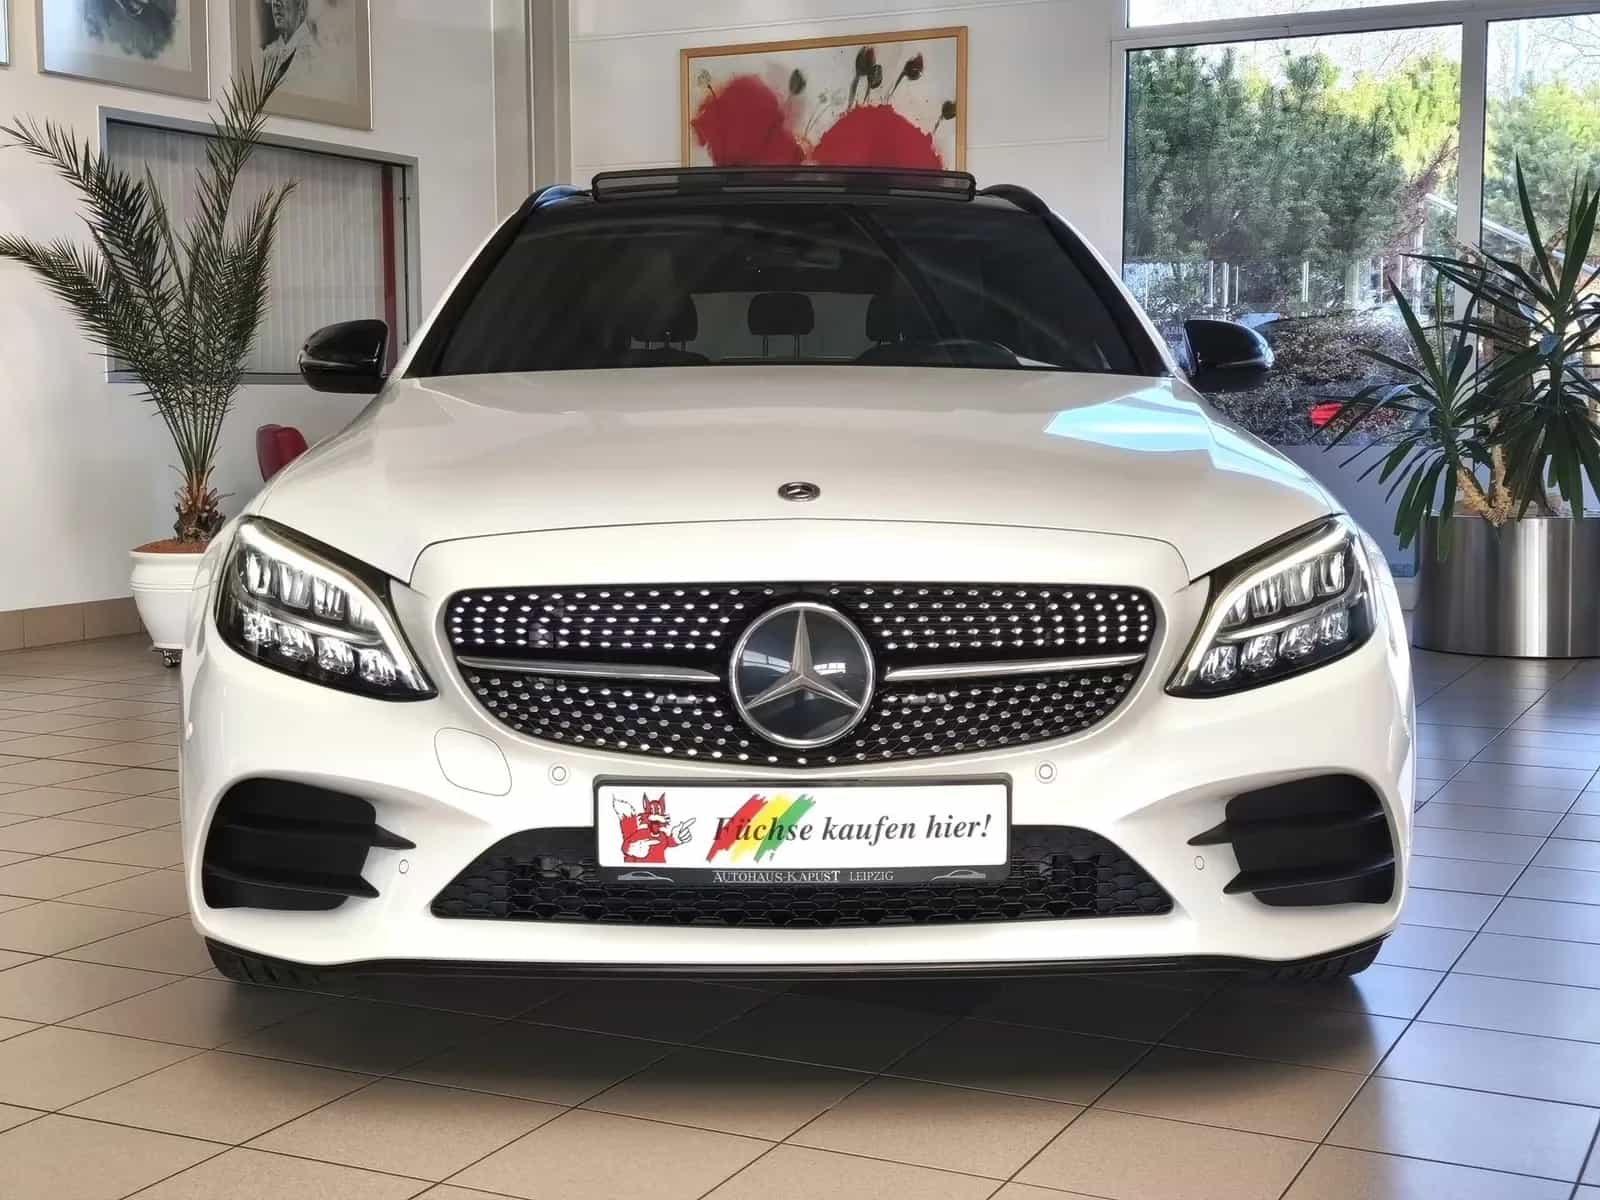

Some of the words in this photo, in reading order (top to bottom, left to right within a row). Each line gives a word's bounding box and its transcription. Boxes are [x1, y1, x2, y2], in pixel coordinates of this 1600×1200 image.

[713, 816, 813, 841] Füchse
[822, 815, 916, 846] kaufen
[925, 814, 992, 839] hier!
[849, 871, 894, 882] LEIPZIG
